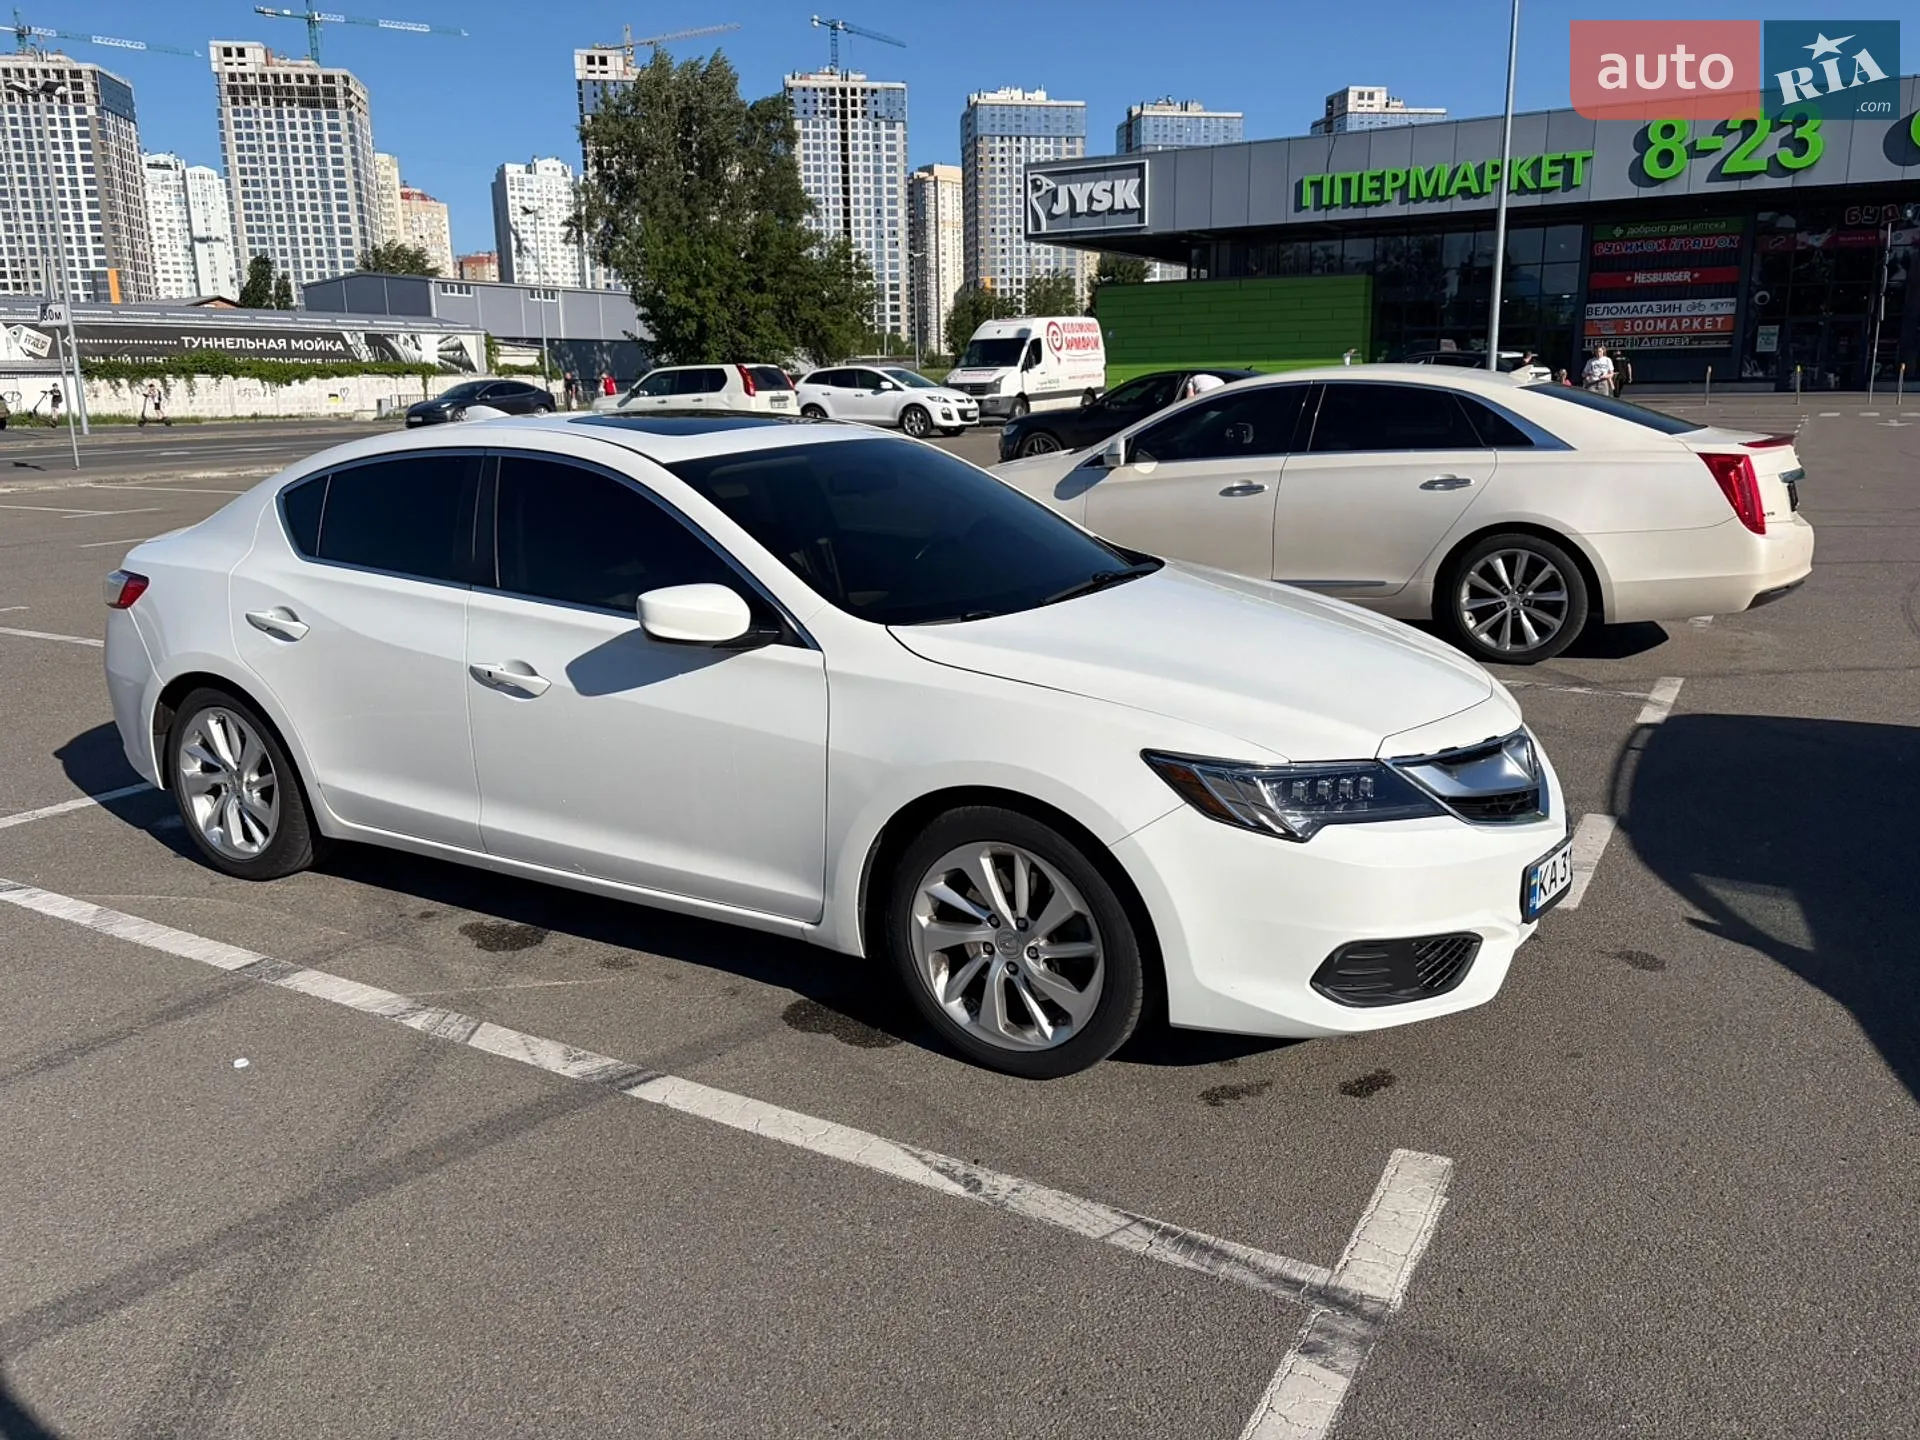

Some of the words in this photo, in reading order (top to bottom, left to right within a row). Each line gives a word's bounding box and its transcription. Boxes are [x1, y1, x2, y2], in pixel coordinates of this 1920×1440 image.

[1302, 150, 1594, 207] ГІПЕРМАРКЕТ
[1643, 103, 1825, 180] 8-23
[1051, 178, 1141, 215] JYSK
[1586, 303, 1683, 317] ВЕЛОМАГАЗИН
[1623, 317, 1725, 332] ЗООМАРКЕТ
[181, 336, 287, 350] ТУННЕЛЬНАЯ
[291, 337, 345, 351] МОЙКА
[1538, 860, 1558, 902] KA
